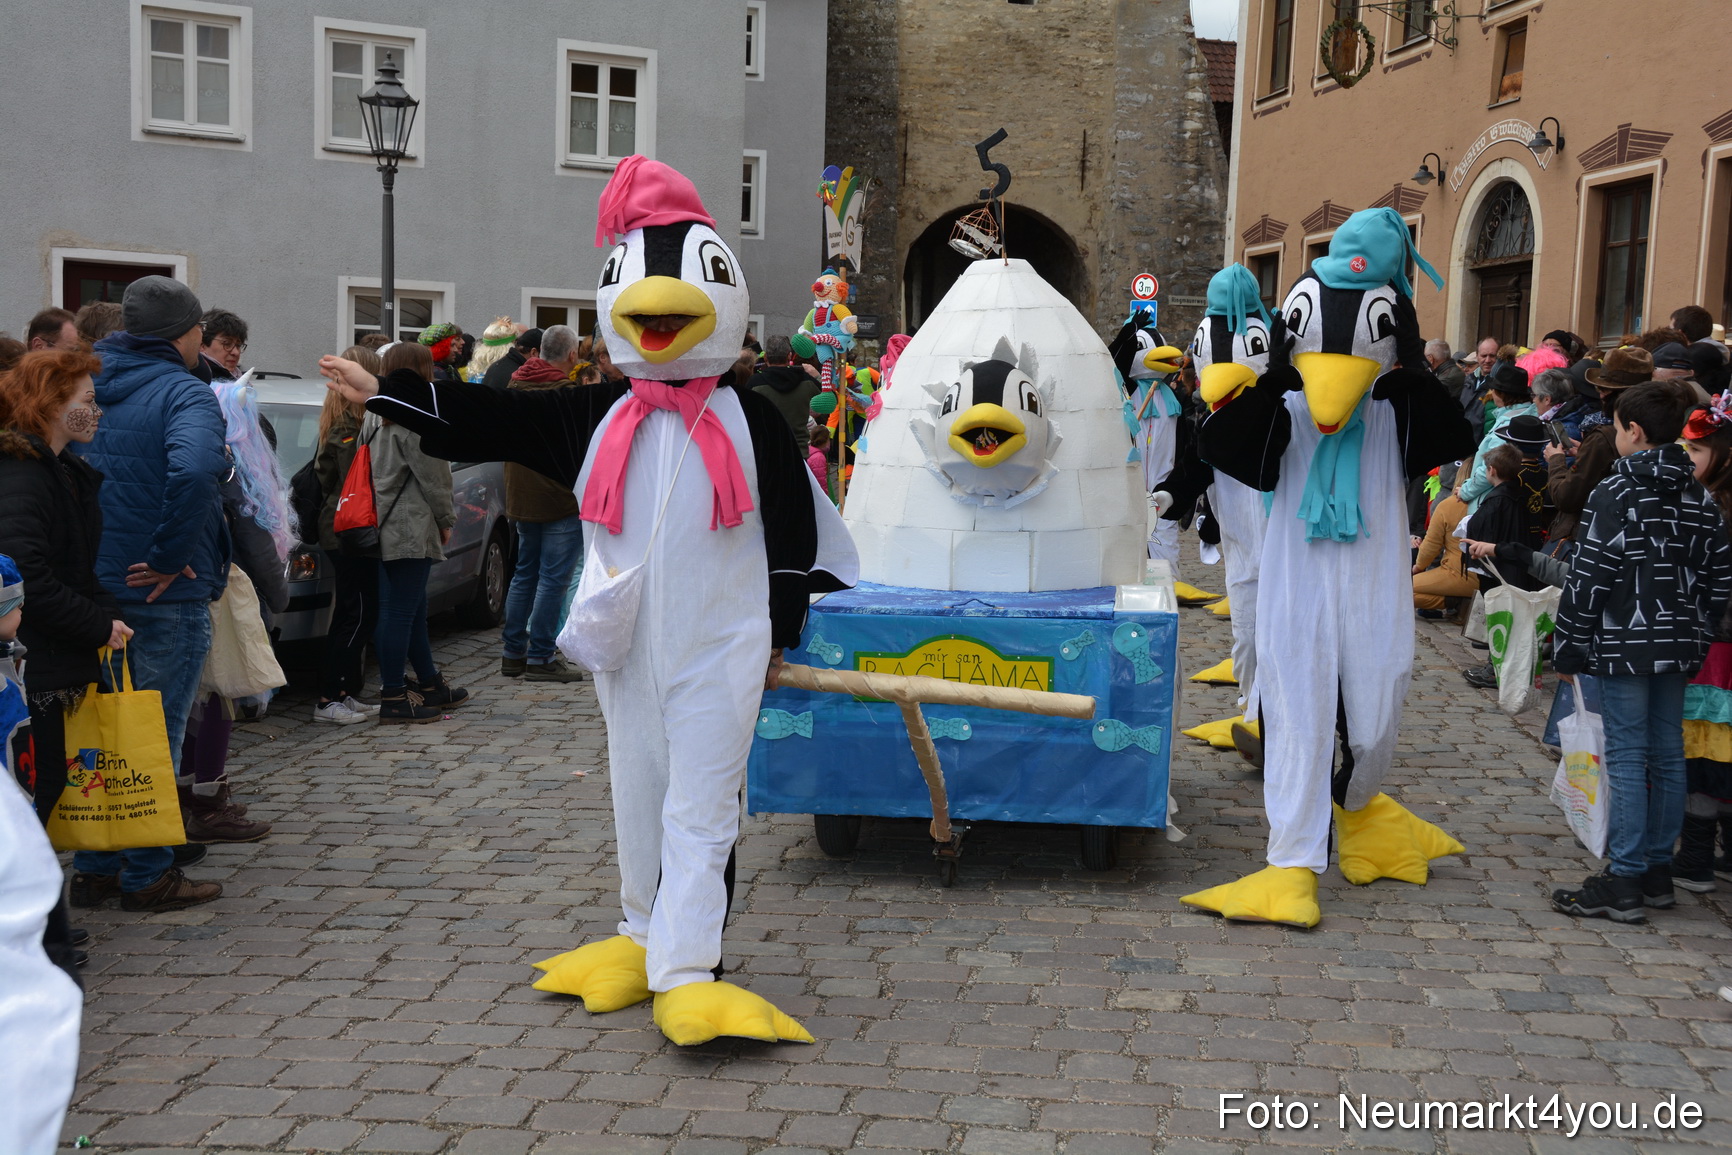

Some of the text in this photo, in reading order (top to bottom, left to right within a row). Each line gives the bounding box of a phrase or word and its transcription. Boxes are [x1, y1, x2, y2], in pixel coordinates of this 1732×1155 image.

[1458, 136, 1486, 175] Bistro
[975, 127, 1011, 200] 5
[1138, 281, 1144, 293] 3
[955, 653, 983, 665] san
[97, 804, 102, 812] 3
[124, 798, 156, 811] Ingolstadt
[58, 813, 68, 821] Tel.
[115, 813, 126, 821] Fax
